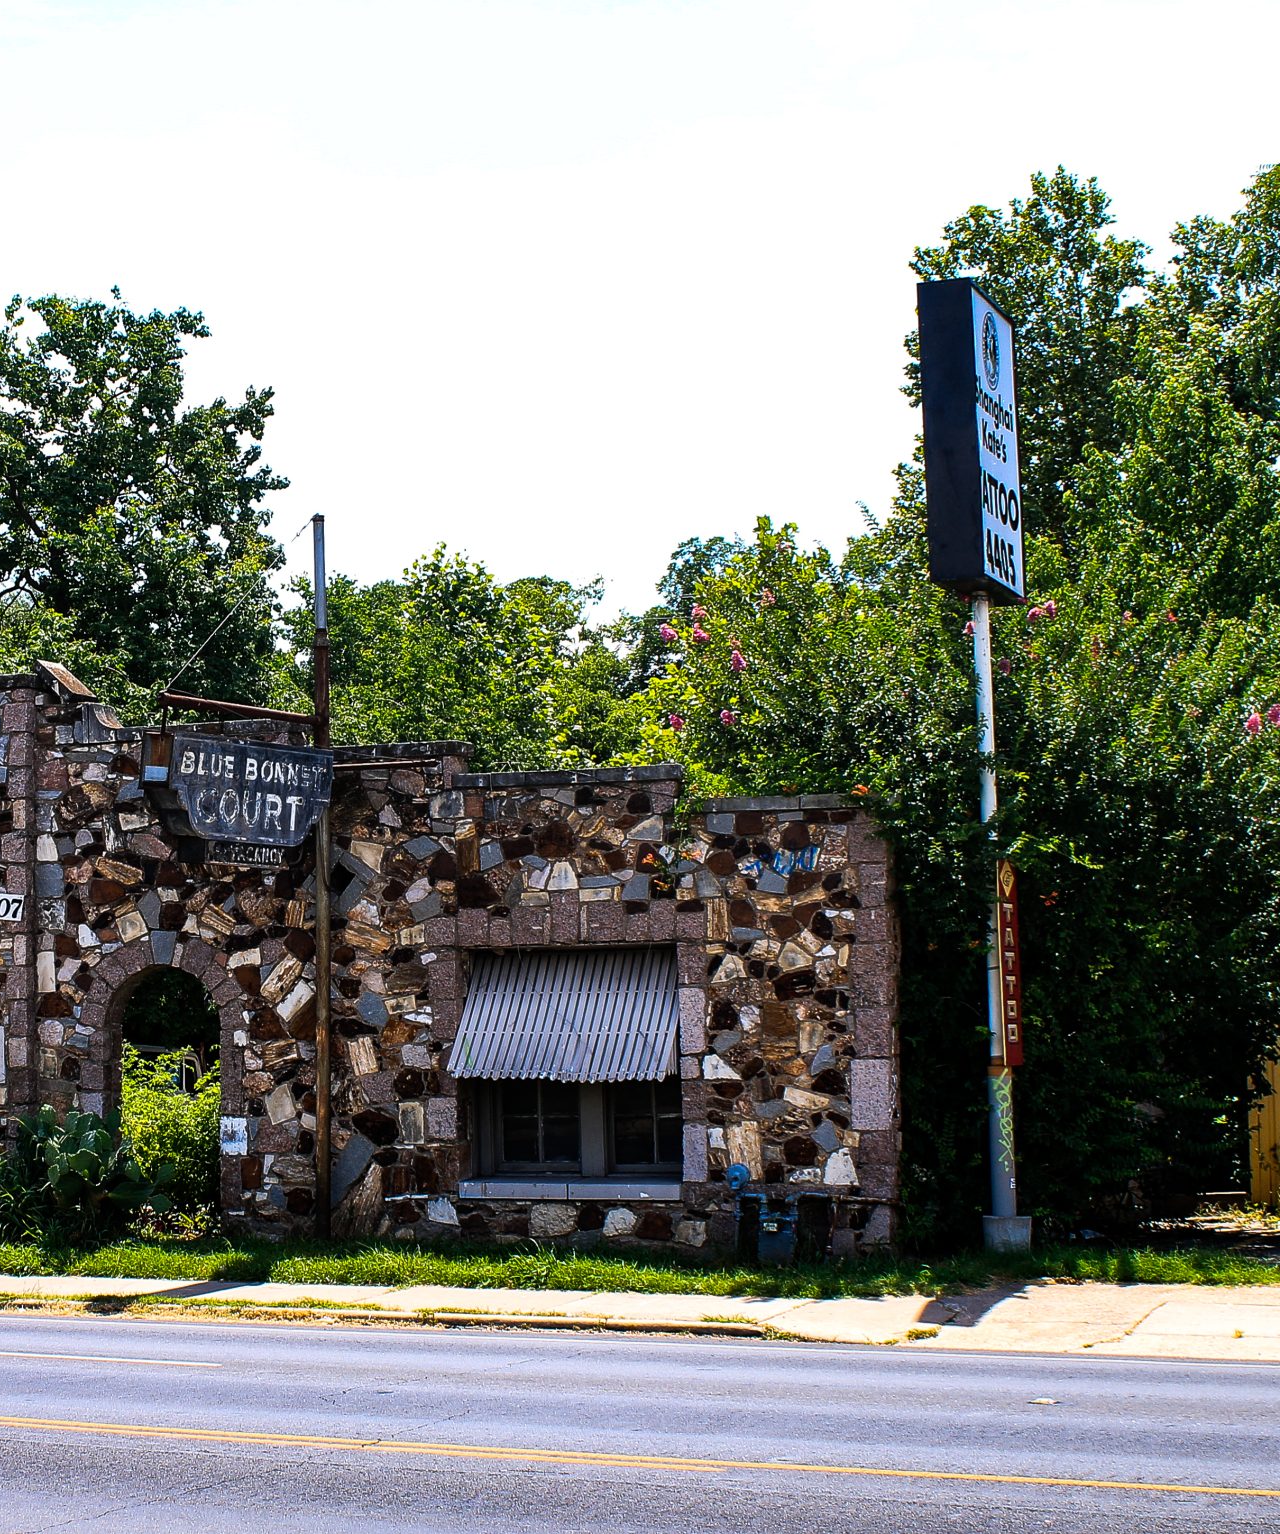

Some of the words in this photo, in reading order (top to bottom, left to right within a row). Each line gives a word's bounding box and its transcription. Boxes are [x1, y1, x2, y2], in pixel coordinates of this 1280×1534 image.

[981, 418, 1007, 464] Kate's
[979, 466, 1020, 532] ATTOO
[985, 528, 1017, 587] 4405
[180, 750, 235, 779] BLUE
[196, 787, 306, 832] COURT
[1002, 903, 1019, 1043] TATTOO
